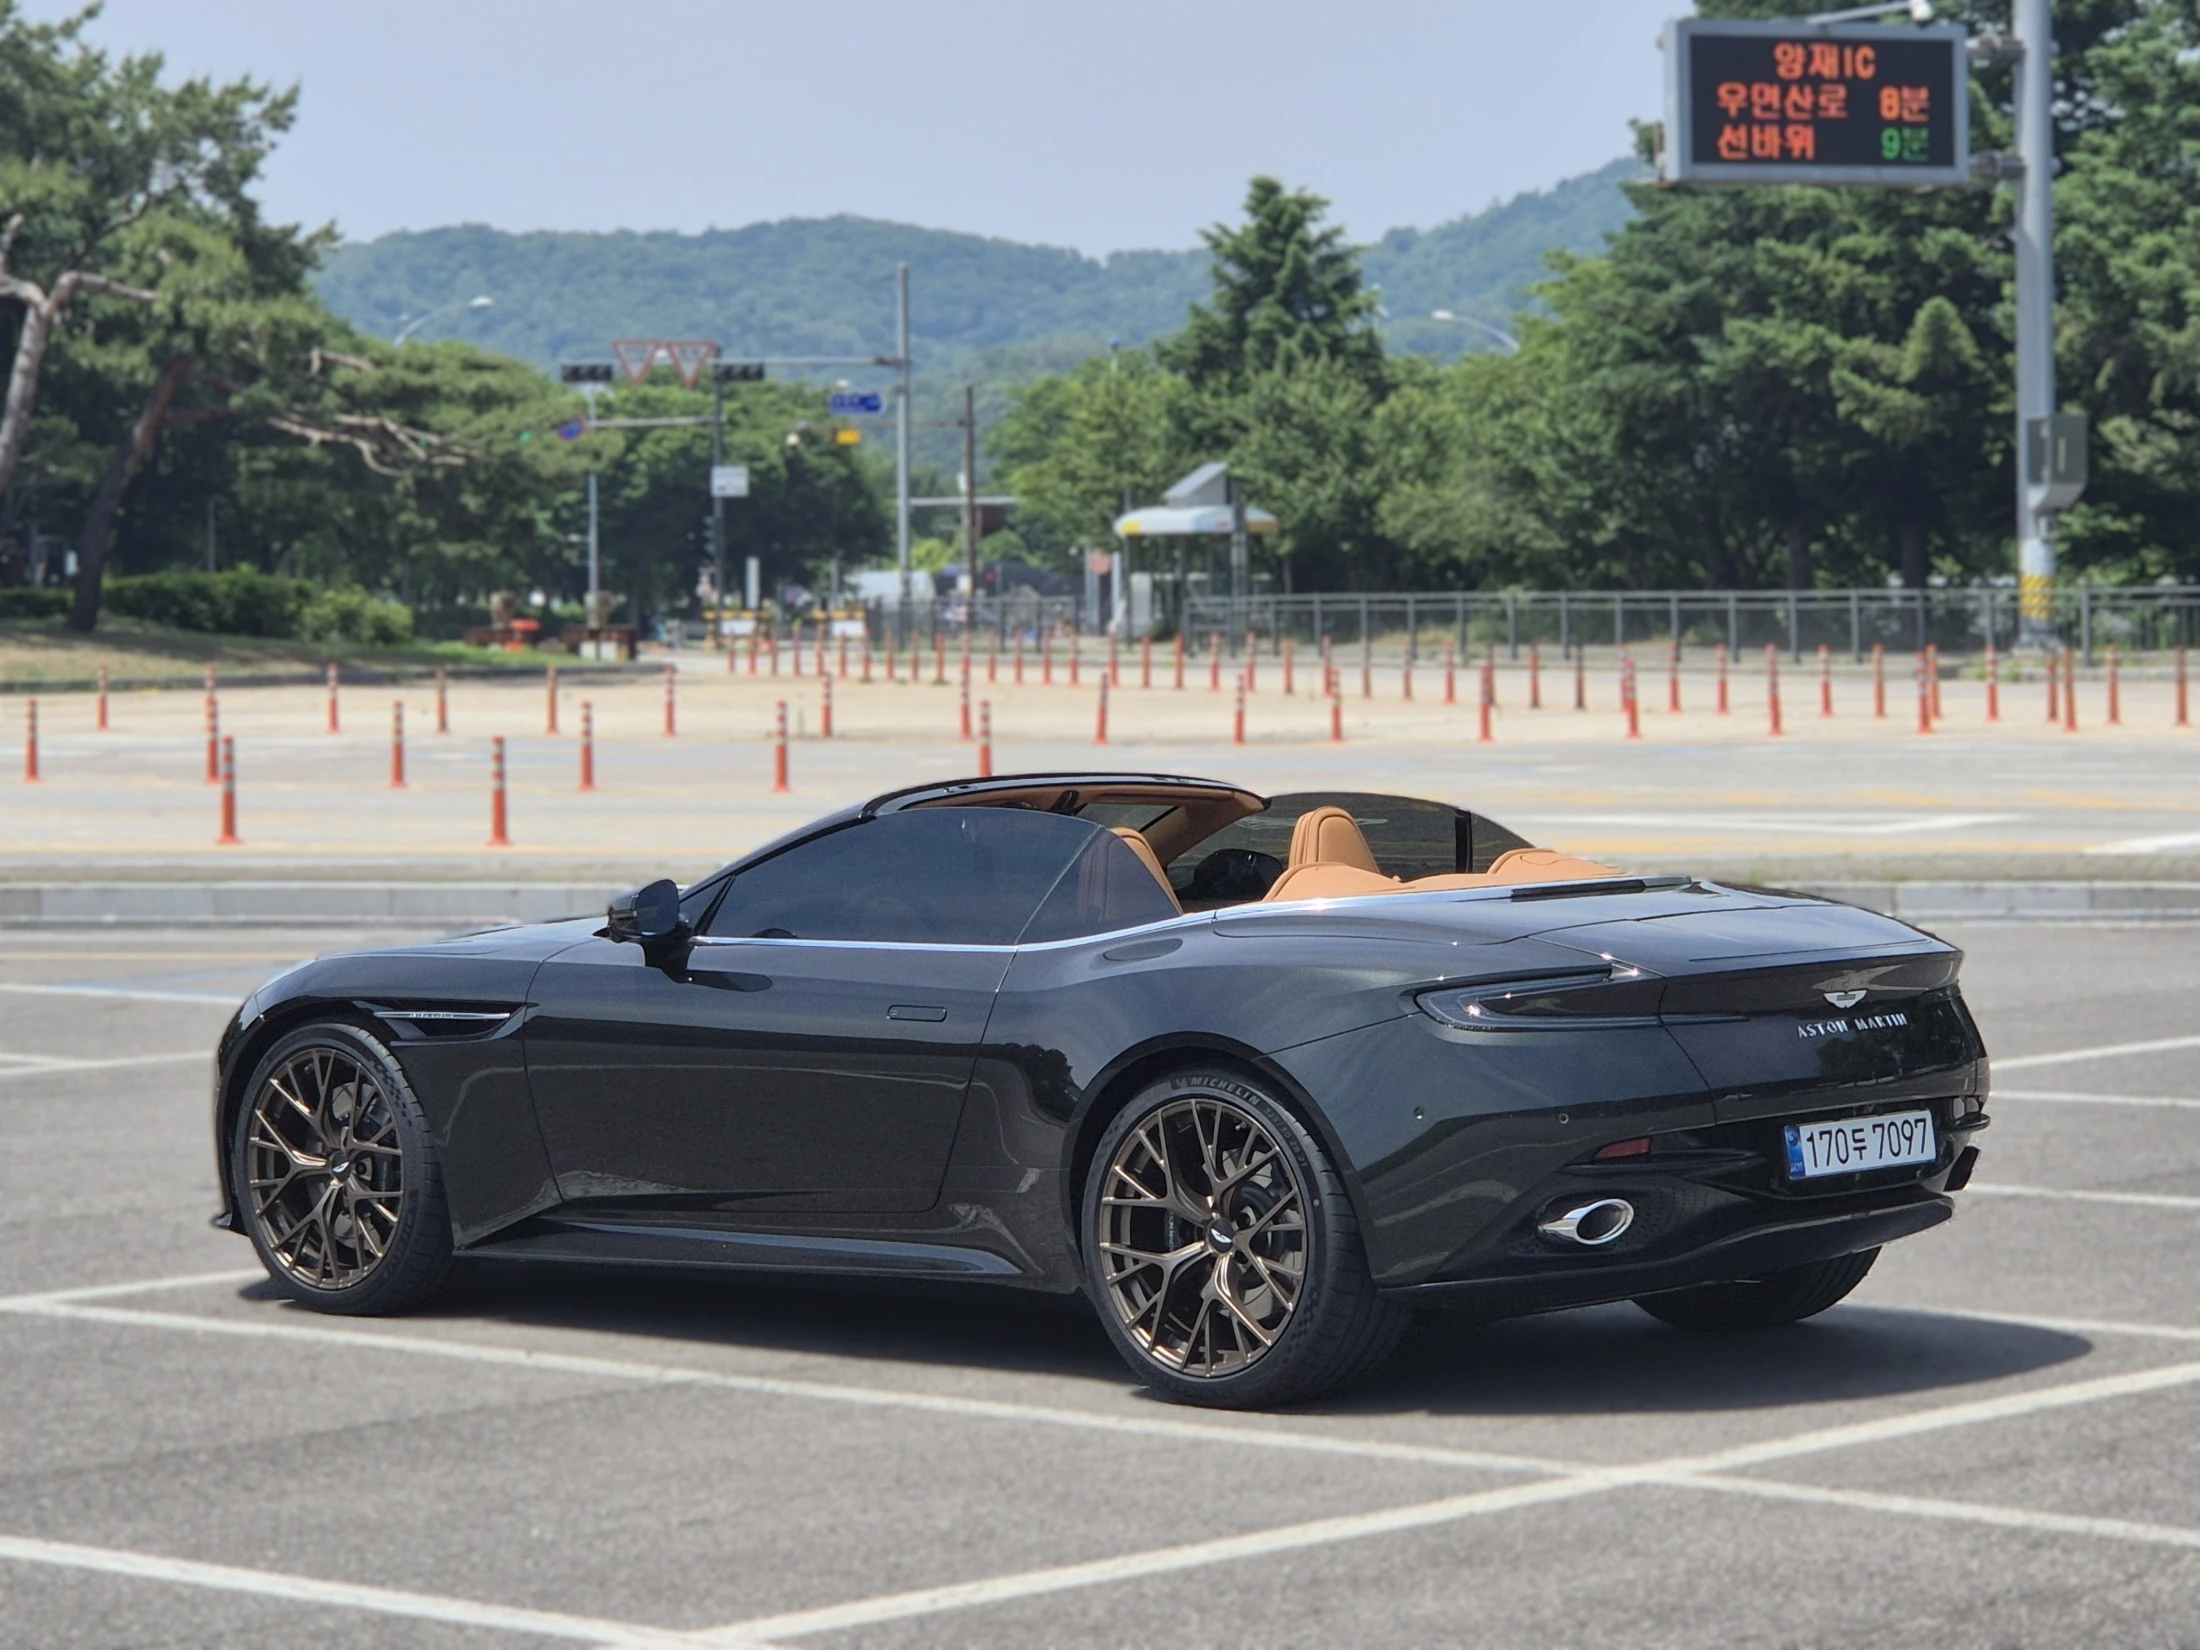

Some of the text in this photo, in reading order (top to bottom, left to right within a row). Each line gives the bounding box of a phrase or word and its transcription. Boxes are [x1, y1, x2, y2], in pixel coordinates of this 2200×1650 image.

[1773, 42, 1876, 79] 양재IC
[1879, 85, 1929, 122] 8분
[1717, 123, 1929, 161] 선바위 9분
[1797, 1013, 1908, 1038] ASTON MARTIN
[1191, 1077, 1260, 1105] MICHELIN
[1872, 1118, 1926, 1159] 7097
